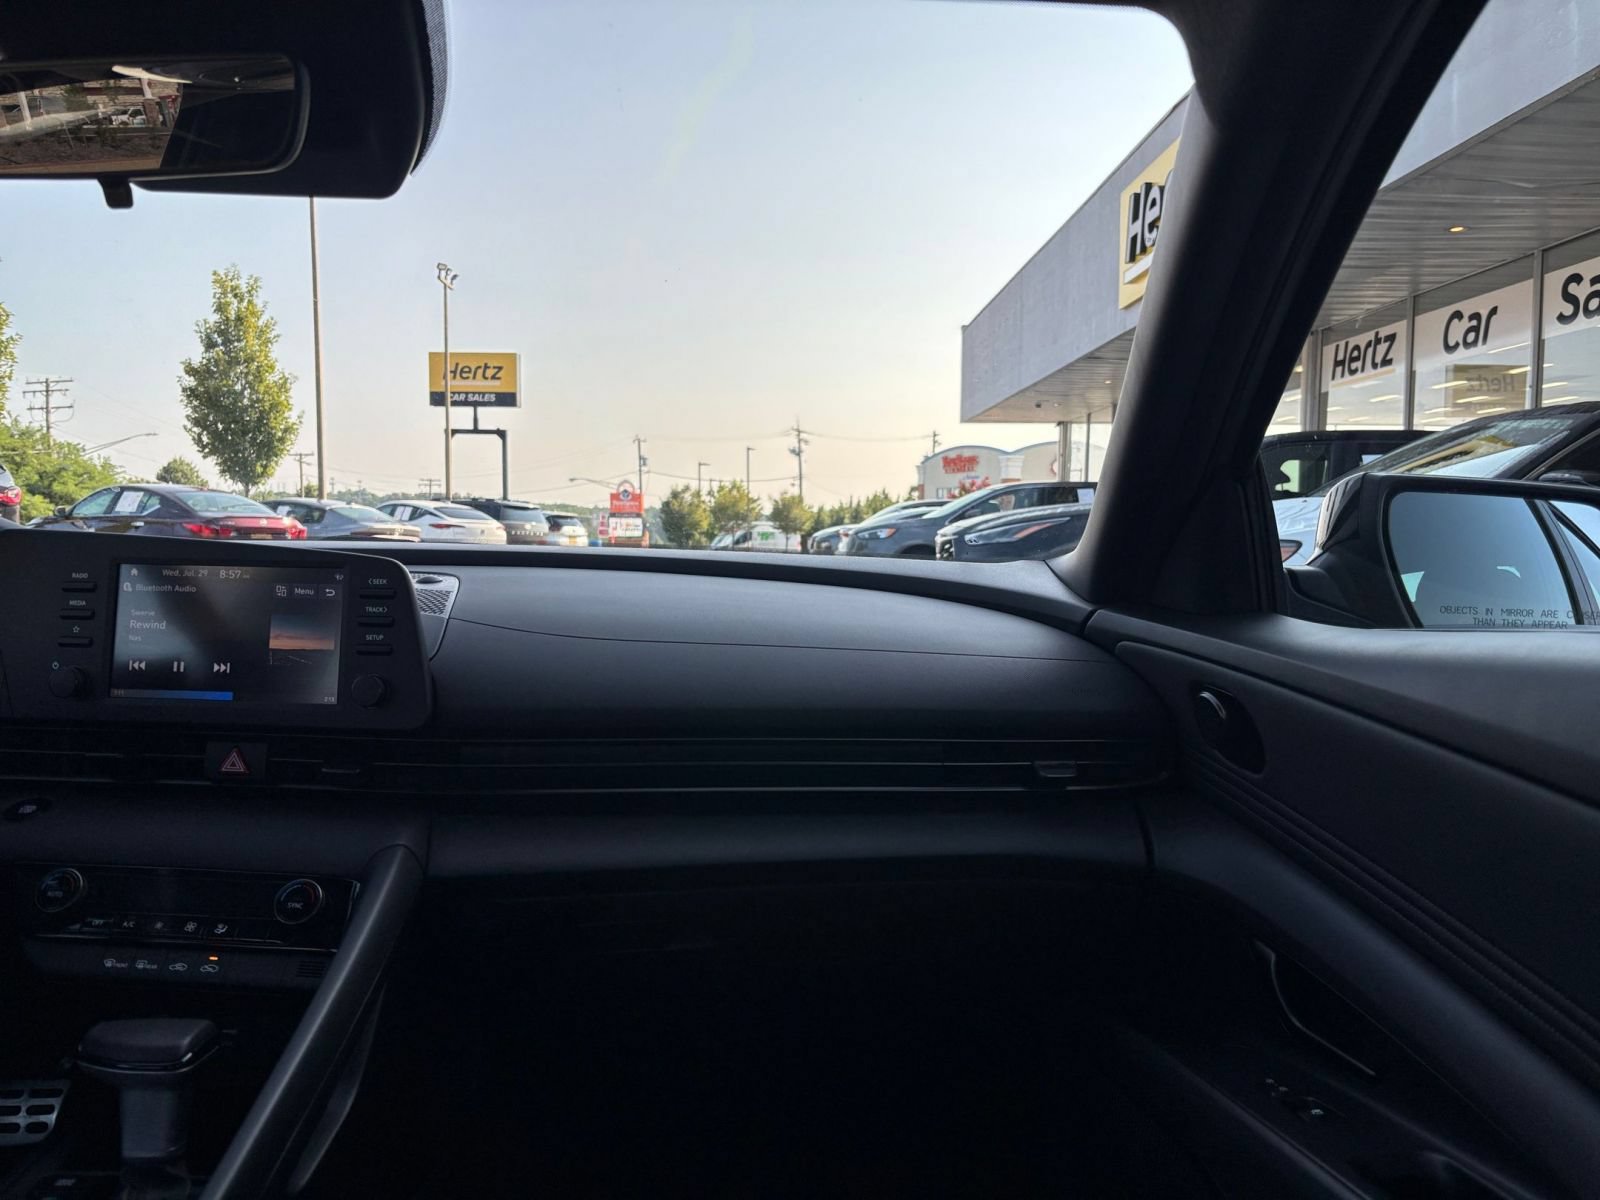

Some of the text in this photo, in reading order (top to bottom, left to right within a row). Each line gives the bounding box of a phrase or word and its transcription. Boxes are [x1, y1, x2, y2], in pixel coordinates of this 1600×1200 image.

[1331, 272, 1600, 381] Hertz Car Sa
[443, 361, 504, 381] Hertz
[467, 393, 496, 402] SALES
[198, 569, 208, 577] 29
[219, 569, 242, 579] 8:57
[135, 583, 197, 593] Bluetooth Audio
[294, 586, 315, 596] Menu
[1439, 605, 1479, 616] OBJECTS
[1485, 607, 1494, 616] IN
[1500, 607, 1534, 618] MIRROR
[1540, 609, 1559, 619] ARE
[129, 619, 167, 630] Rewind
[1473, 617, 1569, 630] THAN THEY APPEAR
